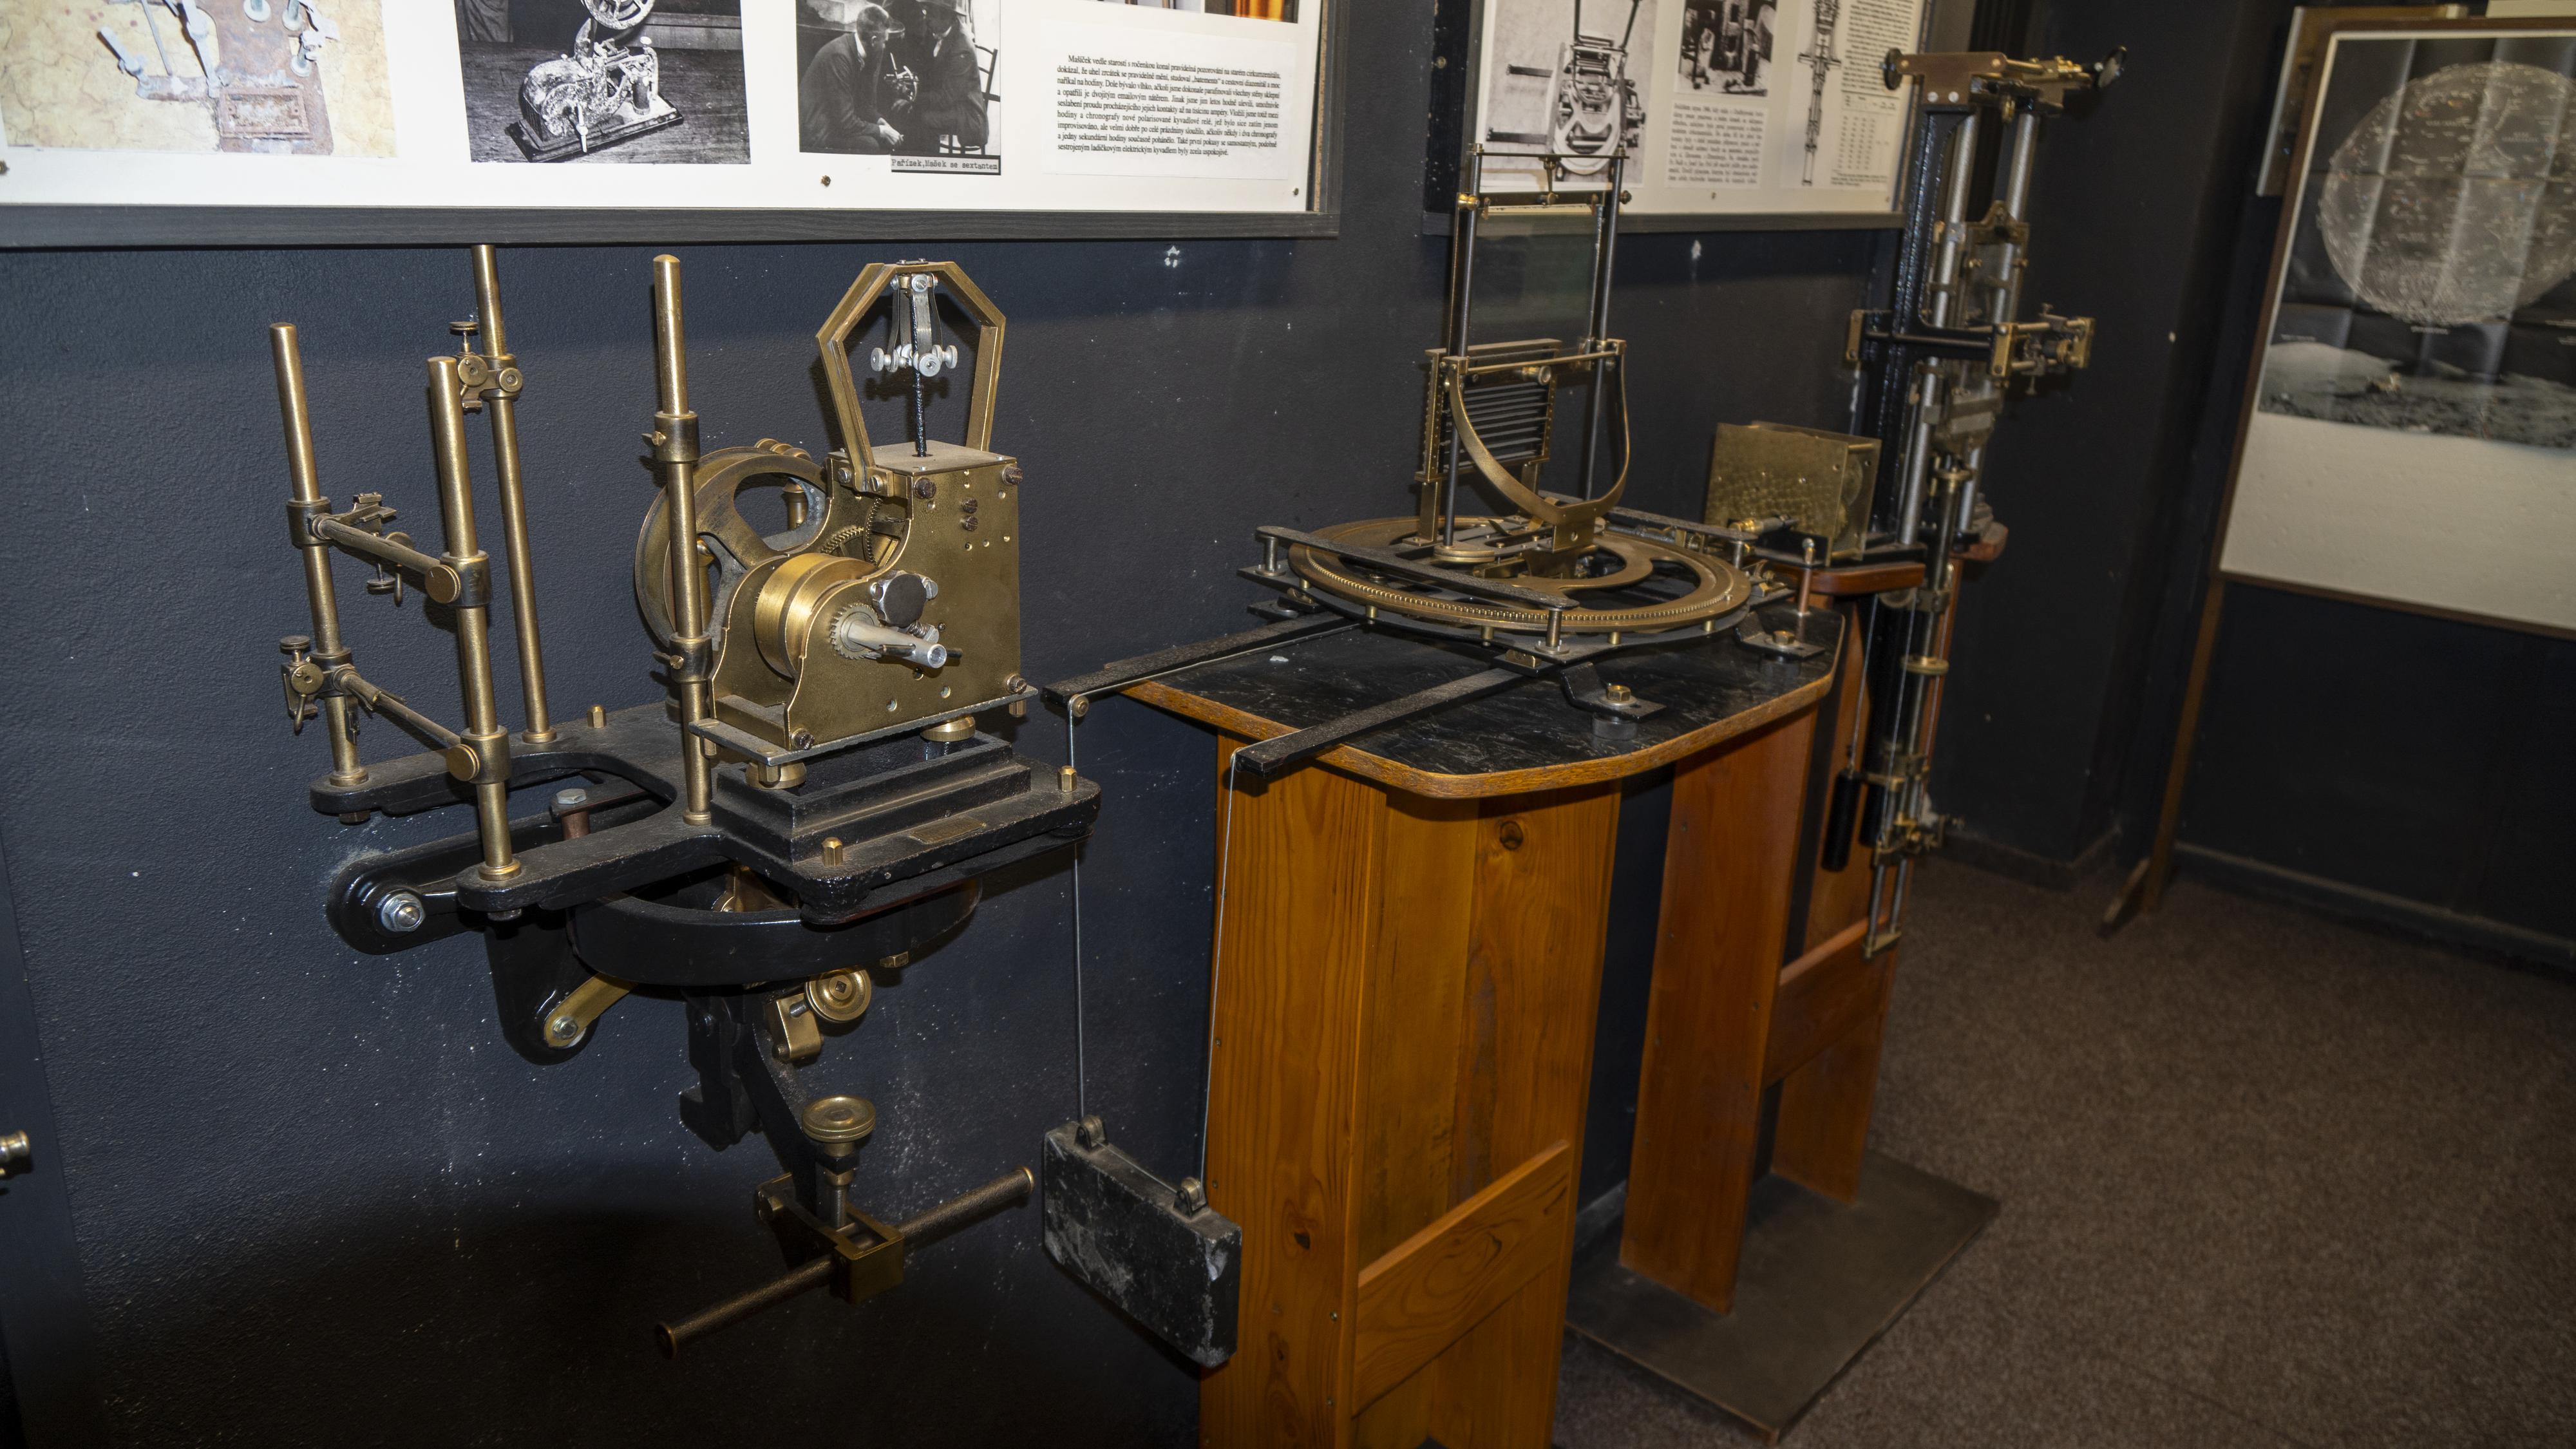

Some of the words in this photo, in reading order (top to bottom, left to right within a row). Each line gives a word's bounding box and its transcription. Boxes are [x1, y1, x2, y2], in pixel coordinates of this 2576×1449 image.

[1106, 79, 1118, 88] Dole
[1084, 90, 1090, 99] je
[1083, 101, 1102, 109] proudu
[1057, 110, 1077, 120] hodiny
[1086, 112, 1120, 122] chronografy
[1224, 119, 1235, 128] bylo
[1109, 134, 1126, 143] hodiny
[962, 162, 998, 170] sextantem
